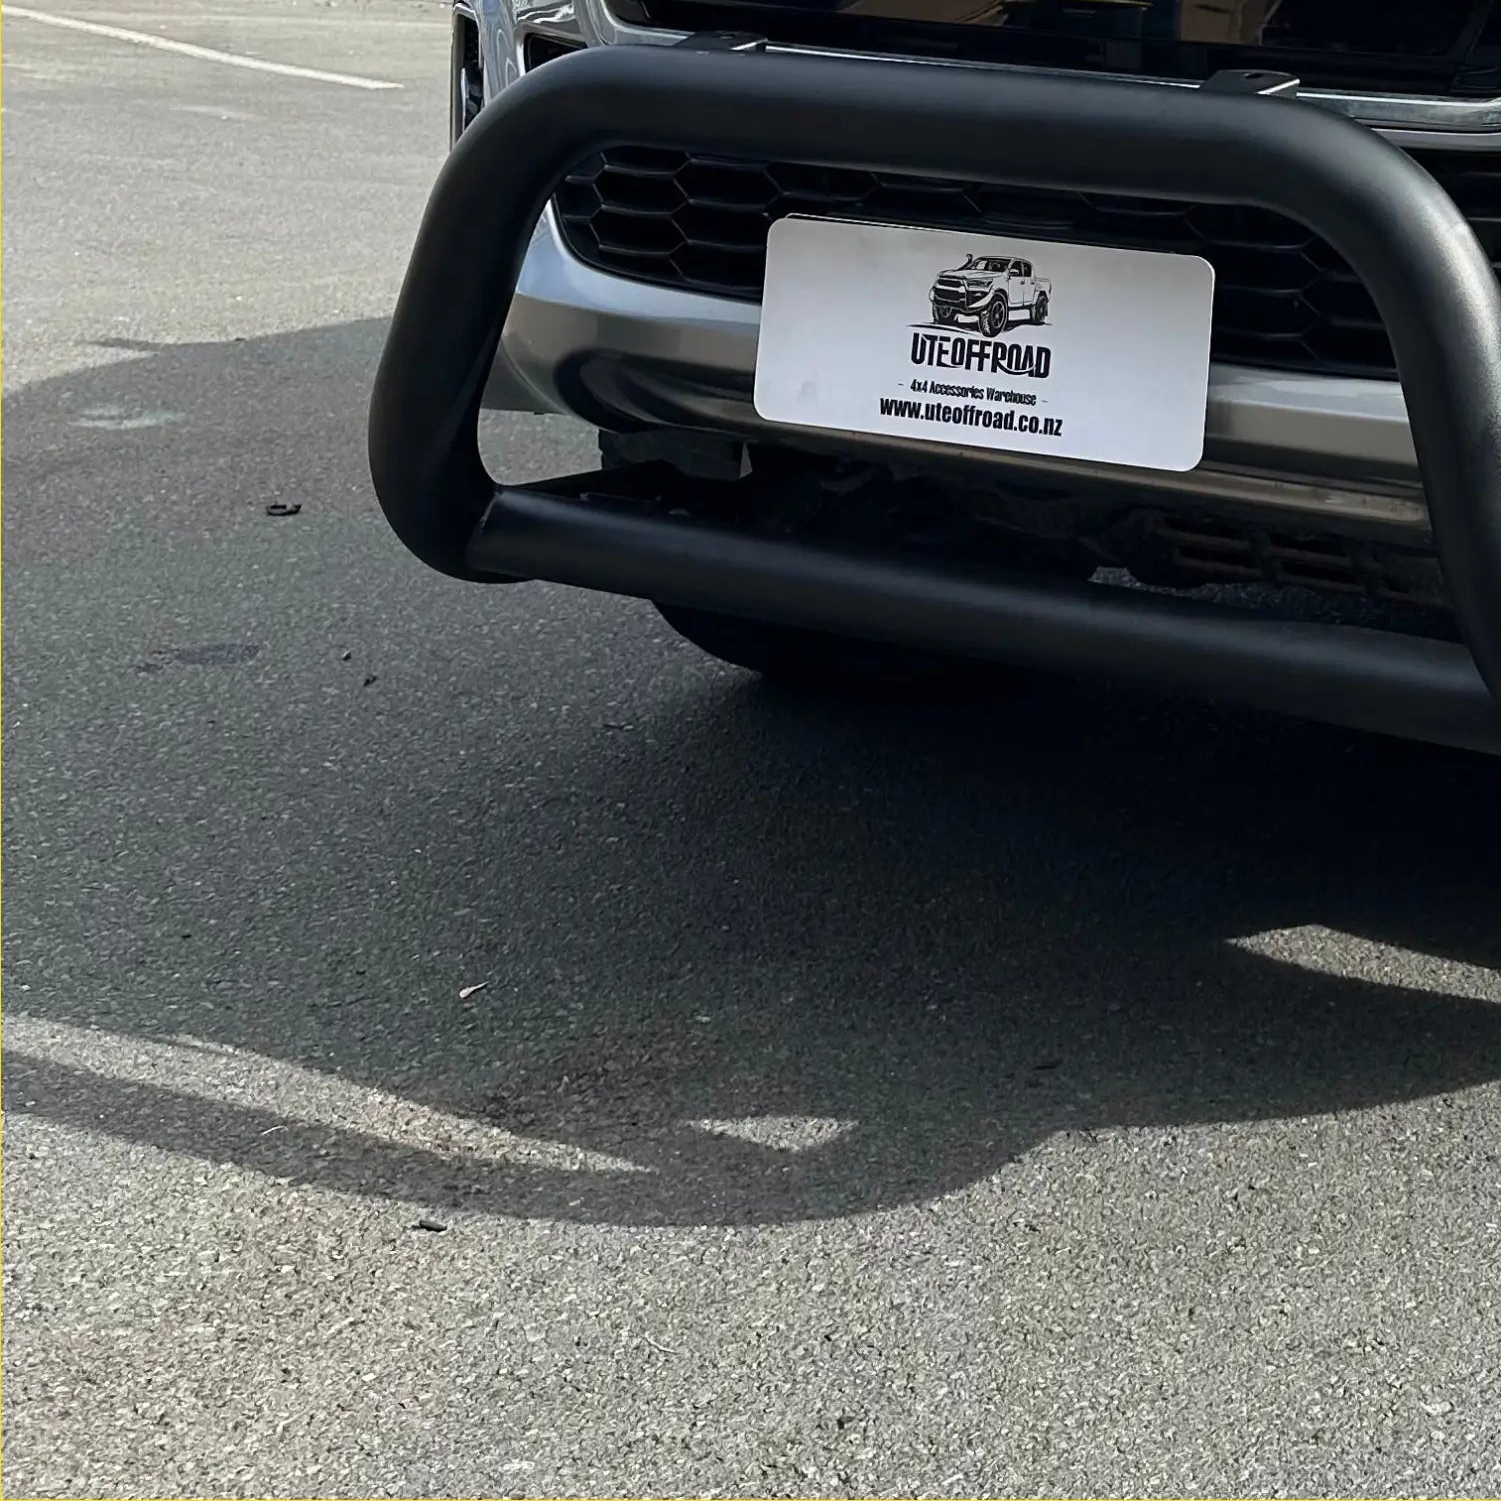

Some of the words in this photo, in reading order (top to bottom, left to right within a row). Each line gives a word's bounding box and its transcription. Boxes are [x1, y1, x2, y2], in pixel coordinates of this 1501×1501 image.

[911, 332, 1052, 379] UTEOFFROAD
[910, 378, 928, 393] 4x4
[928, 381, 985, 400] Accessories
[986, 386, 1037, 407] Warehouse
[879, 397, 1063, 437] www.uteoffroad.co.nz
